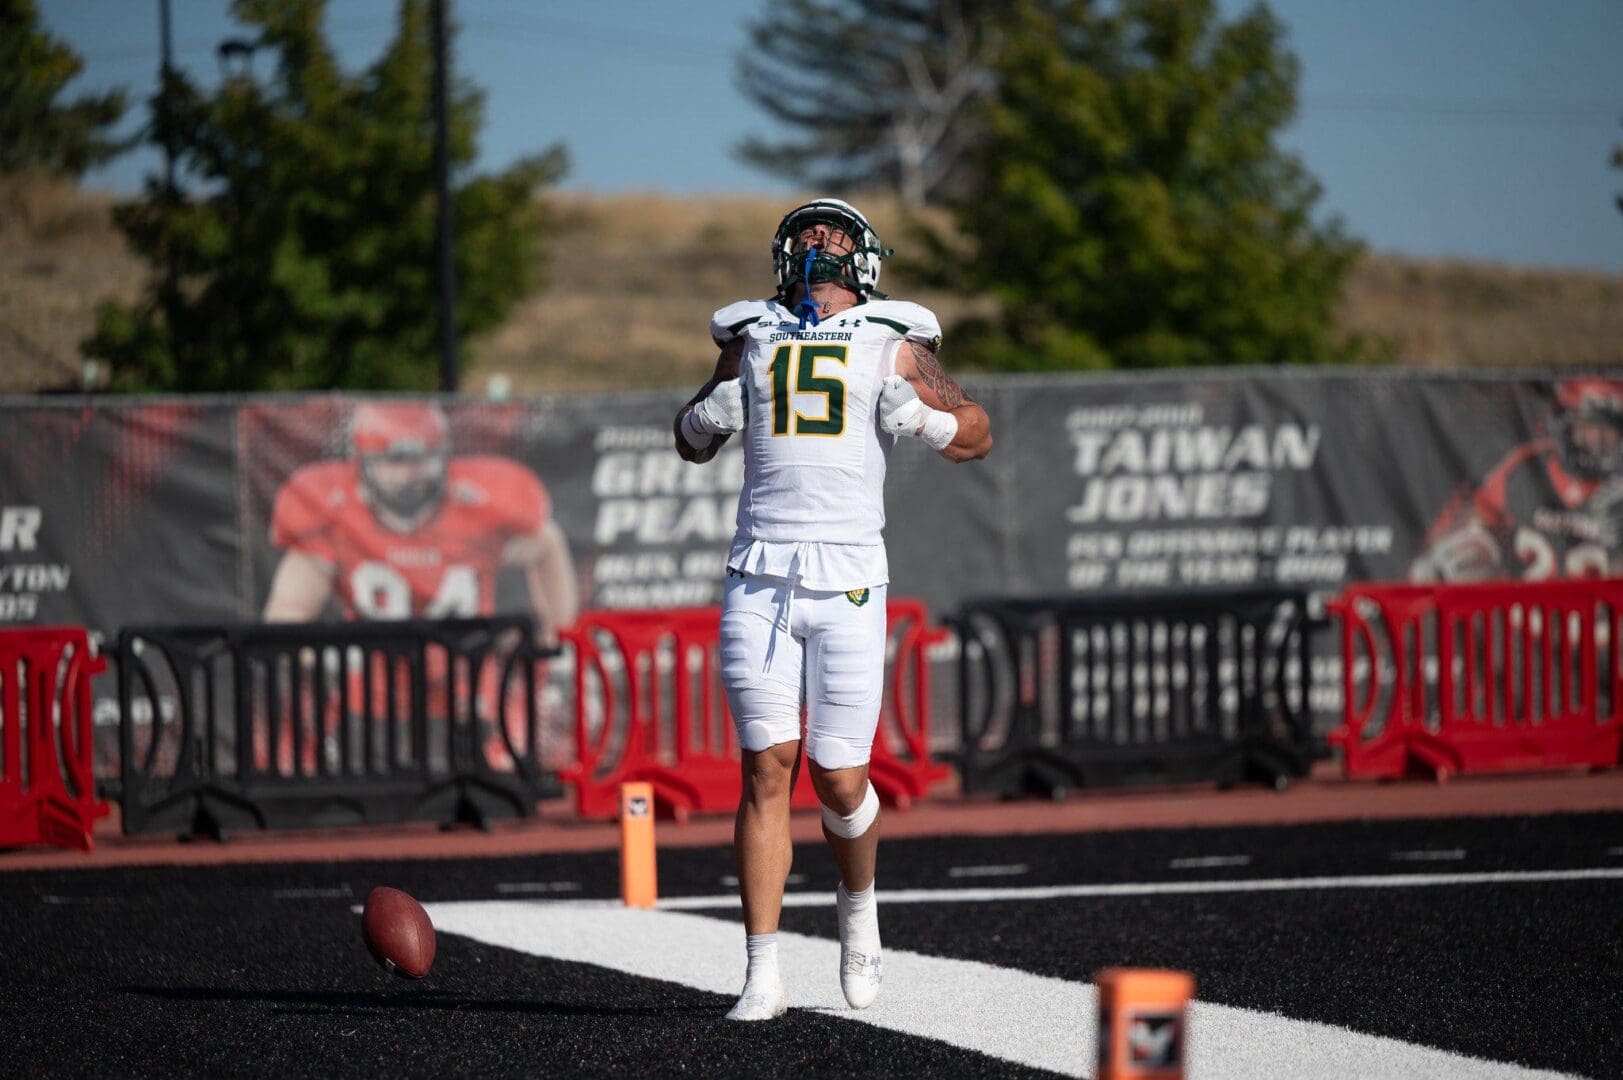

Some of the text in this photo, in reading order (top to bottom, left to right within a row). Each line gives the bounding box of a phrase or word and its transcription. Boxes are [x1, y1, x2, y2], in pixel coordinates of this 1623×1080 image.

[769, 332, 852, 342] SOUTHEASTERN
[767, 343, 848, 437] 15
[1070, 424, 1321, 475] TAIWAN
[1067, 474, 1270, 522] JONES
[1285, 523, 1393, 552] PLAYER
[1117, 559, 1170, 587] THE
[1178, 556, 1257, 584] YEAR
